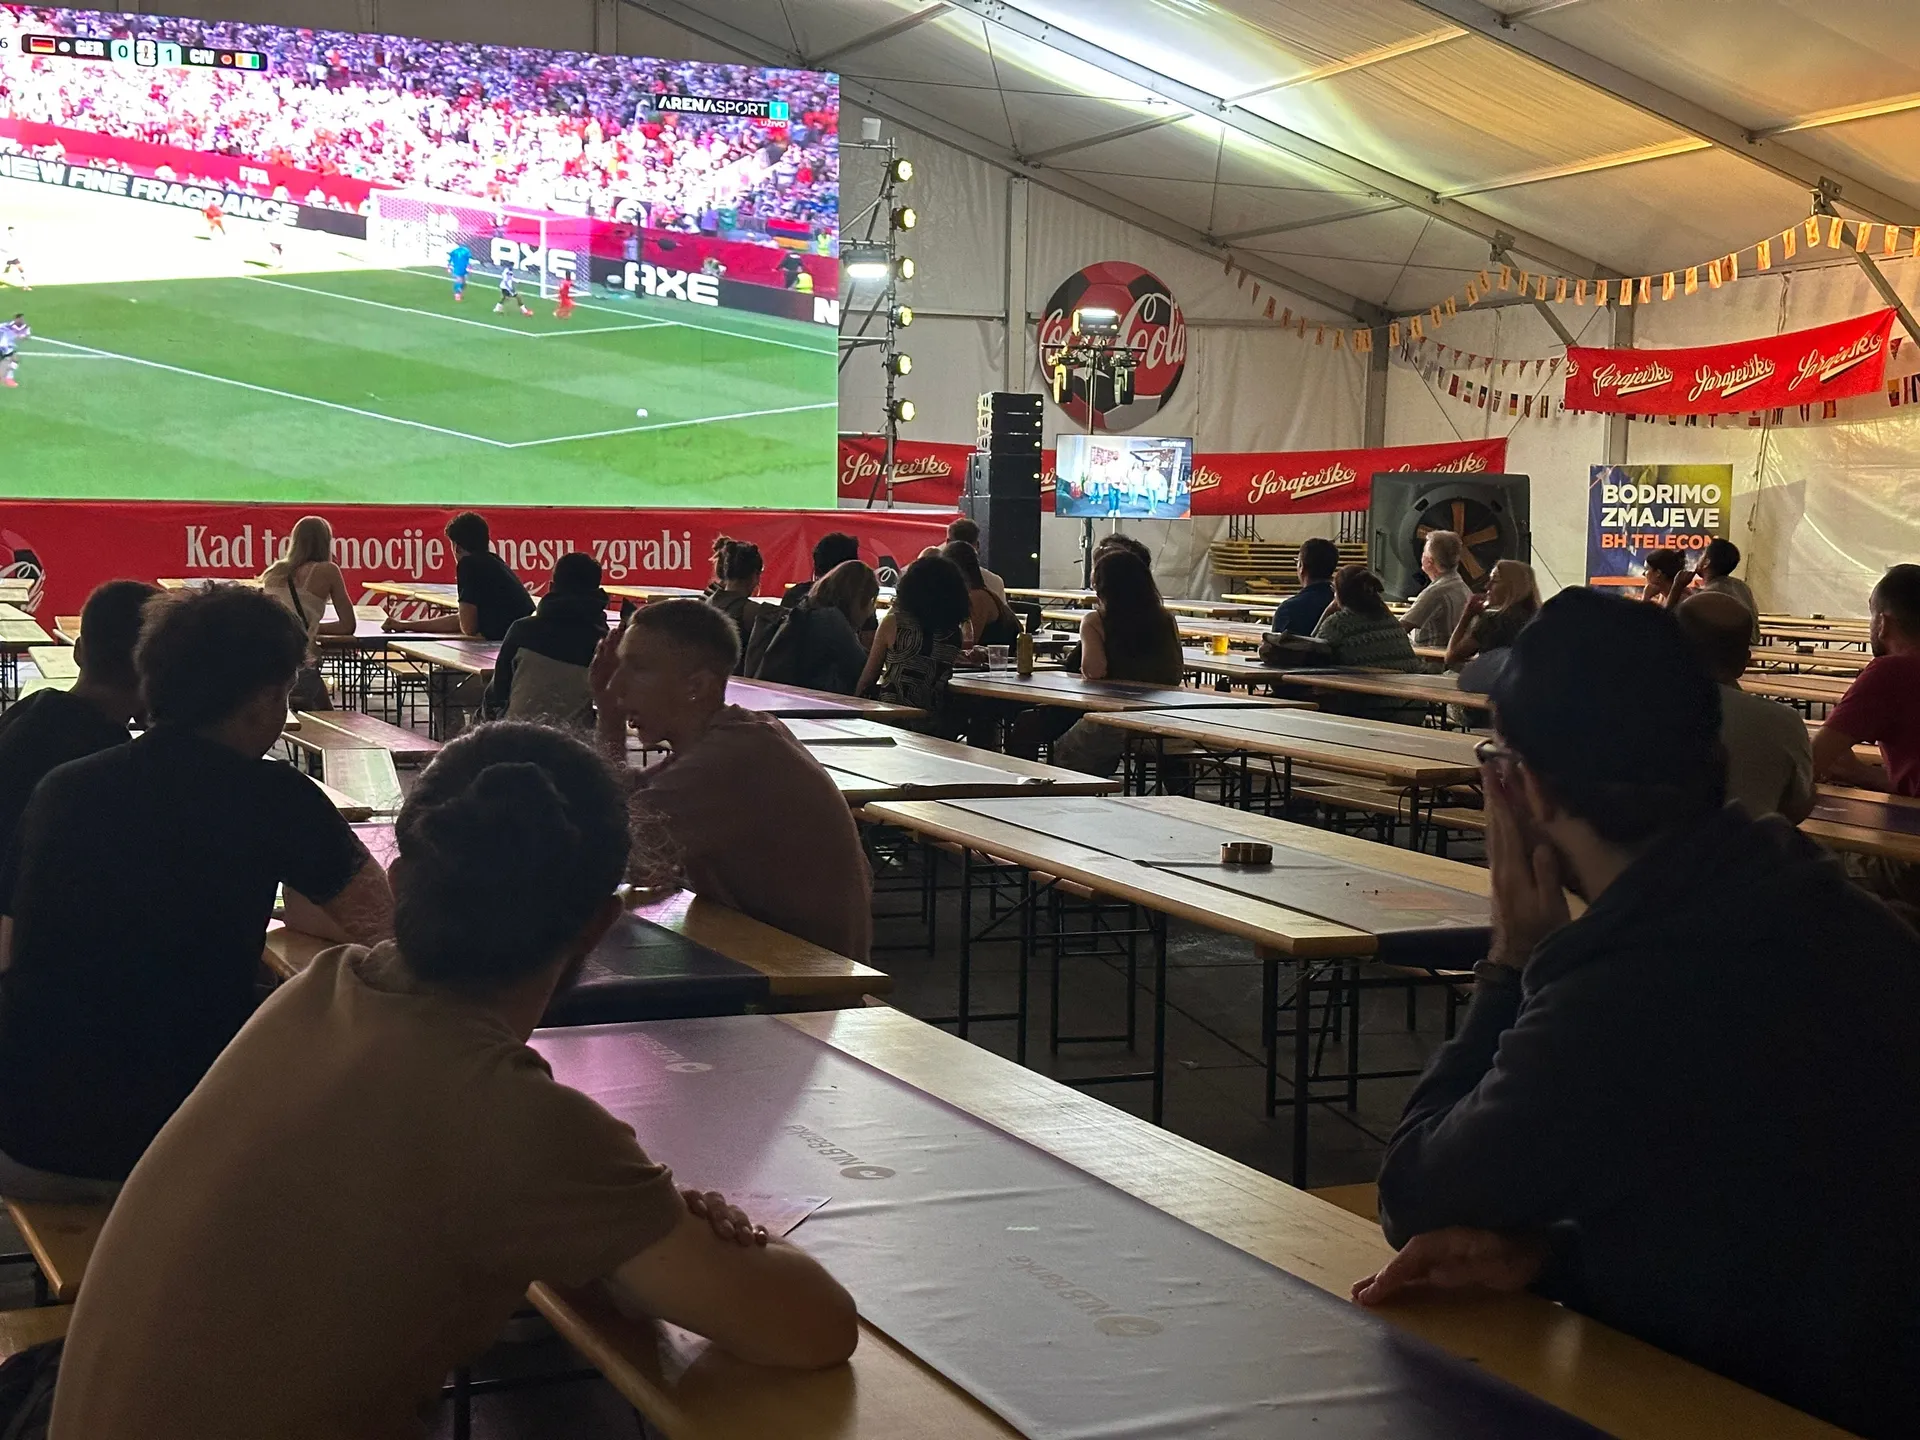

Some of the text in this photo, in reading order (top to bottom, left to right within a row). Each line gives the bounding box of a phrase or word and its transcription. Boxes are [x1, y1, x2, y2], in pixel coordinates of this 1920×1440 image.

[118, 45, 128, 58] 0
[166, 49, 173, 62] 1
[68, 165, 129, 196] FINE
[131, 176, 300, 226] FRAGRANCE
[491, 237, 577, 279] AXE
[624, 261, 719, 306] AXE
[1592, 360, 1674, 397] Sarajevsko
[1687, 353, 1776, 402] Sarajevsko
[1247, 462, 1358, 505] Sarajevsko
[1602, 483, 1722, 505] BODRIMO
[1600, 507, 1720, 528] ZMAJEVE
[185, 524, 255, 569] Kad
[331, 528, 445, 580] mocije
[592, 529, 692, 580] zgrabi
[1602, 533, 1627, 549] BH
